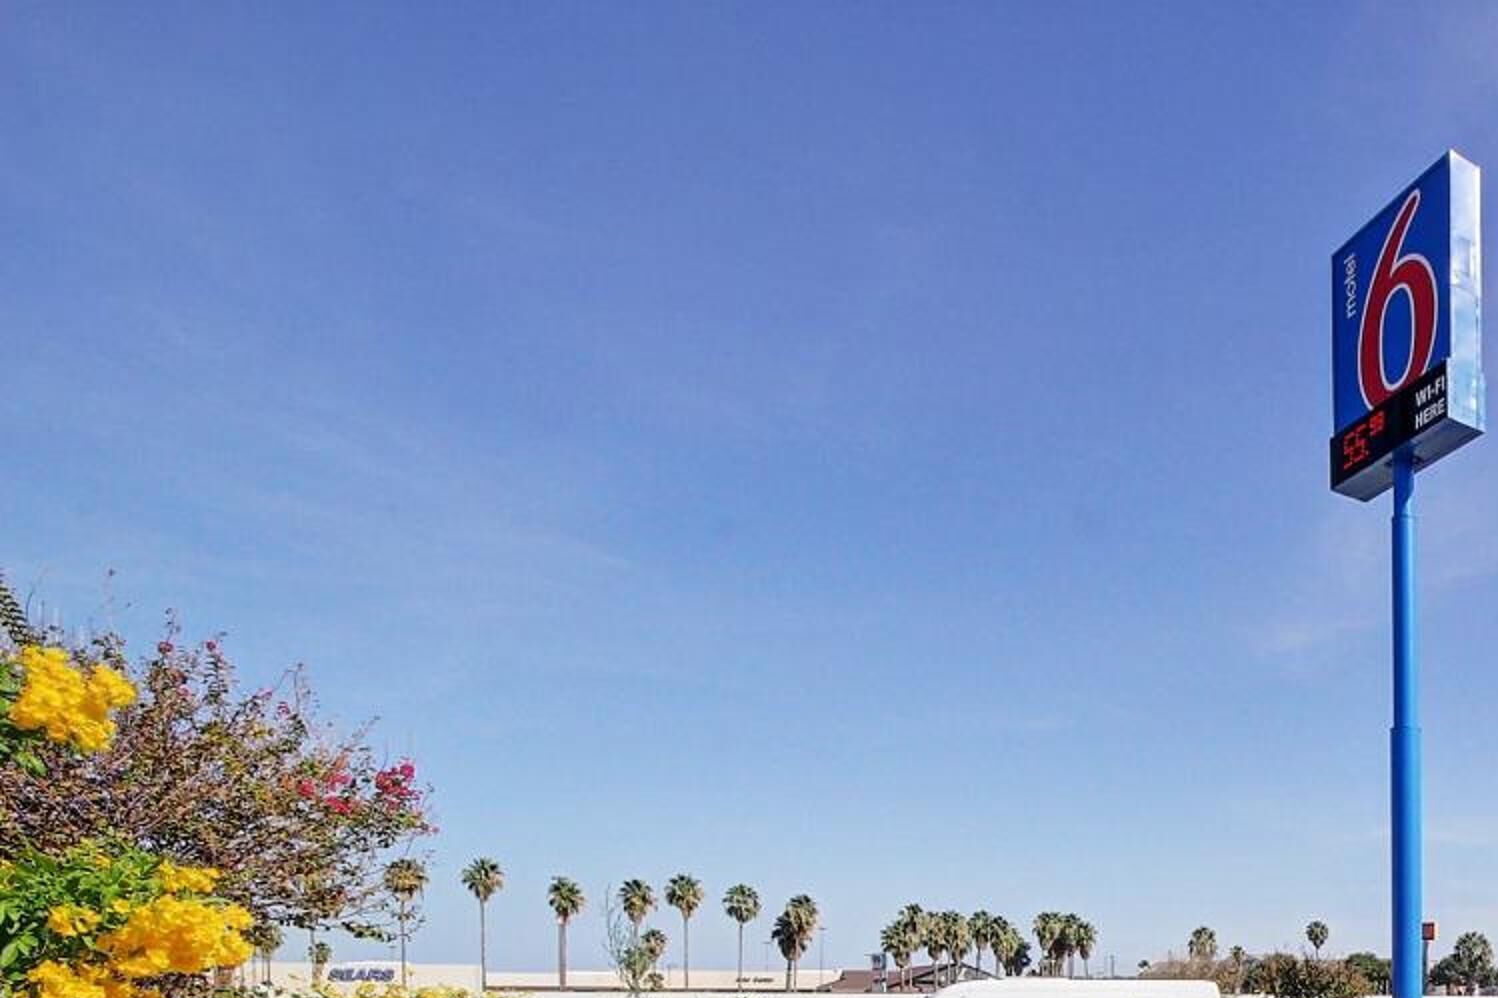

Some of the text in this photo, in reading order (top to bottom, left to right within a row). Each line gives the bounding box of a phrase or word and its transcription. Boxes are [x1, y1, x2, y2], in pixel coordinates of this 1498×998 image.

[1343, 253, 1357, 319] motel
[1357, 189, 1438, 410] 6
[1415, 375, 1446, 407] WI-FI
[1415, 397, 1446, 430] HERE
[328, 967, 395, 982] SEARS
